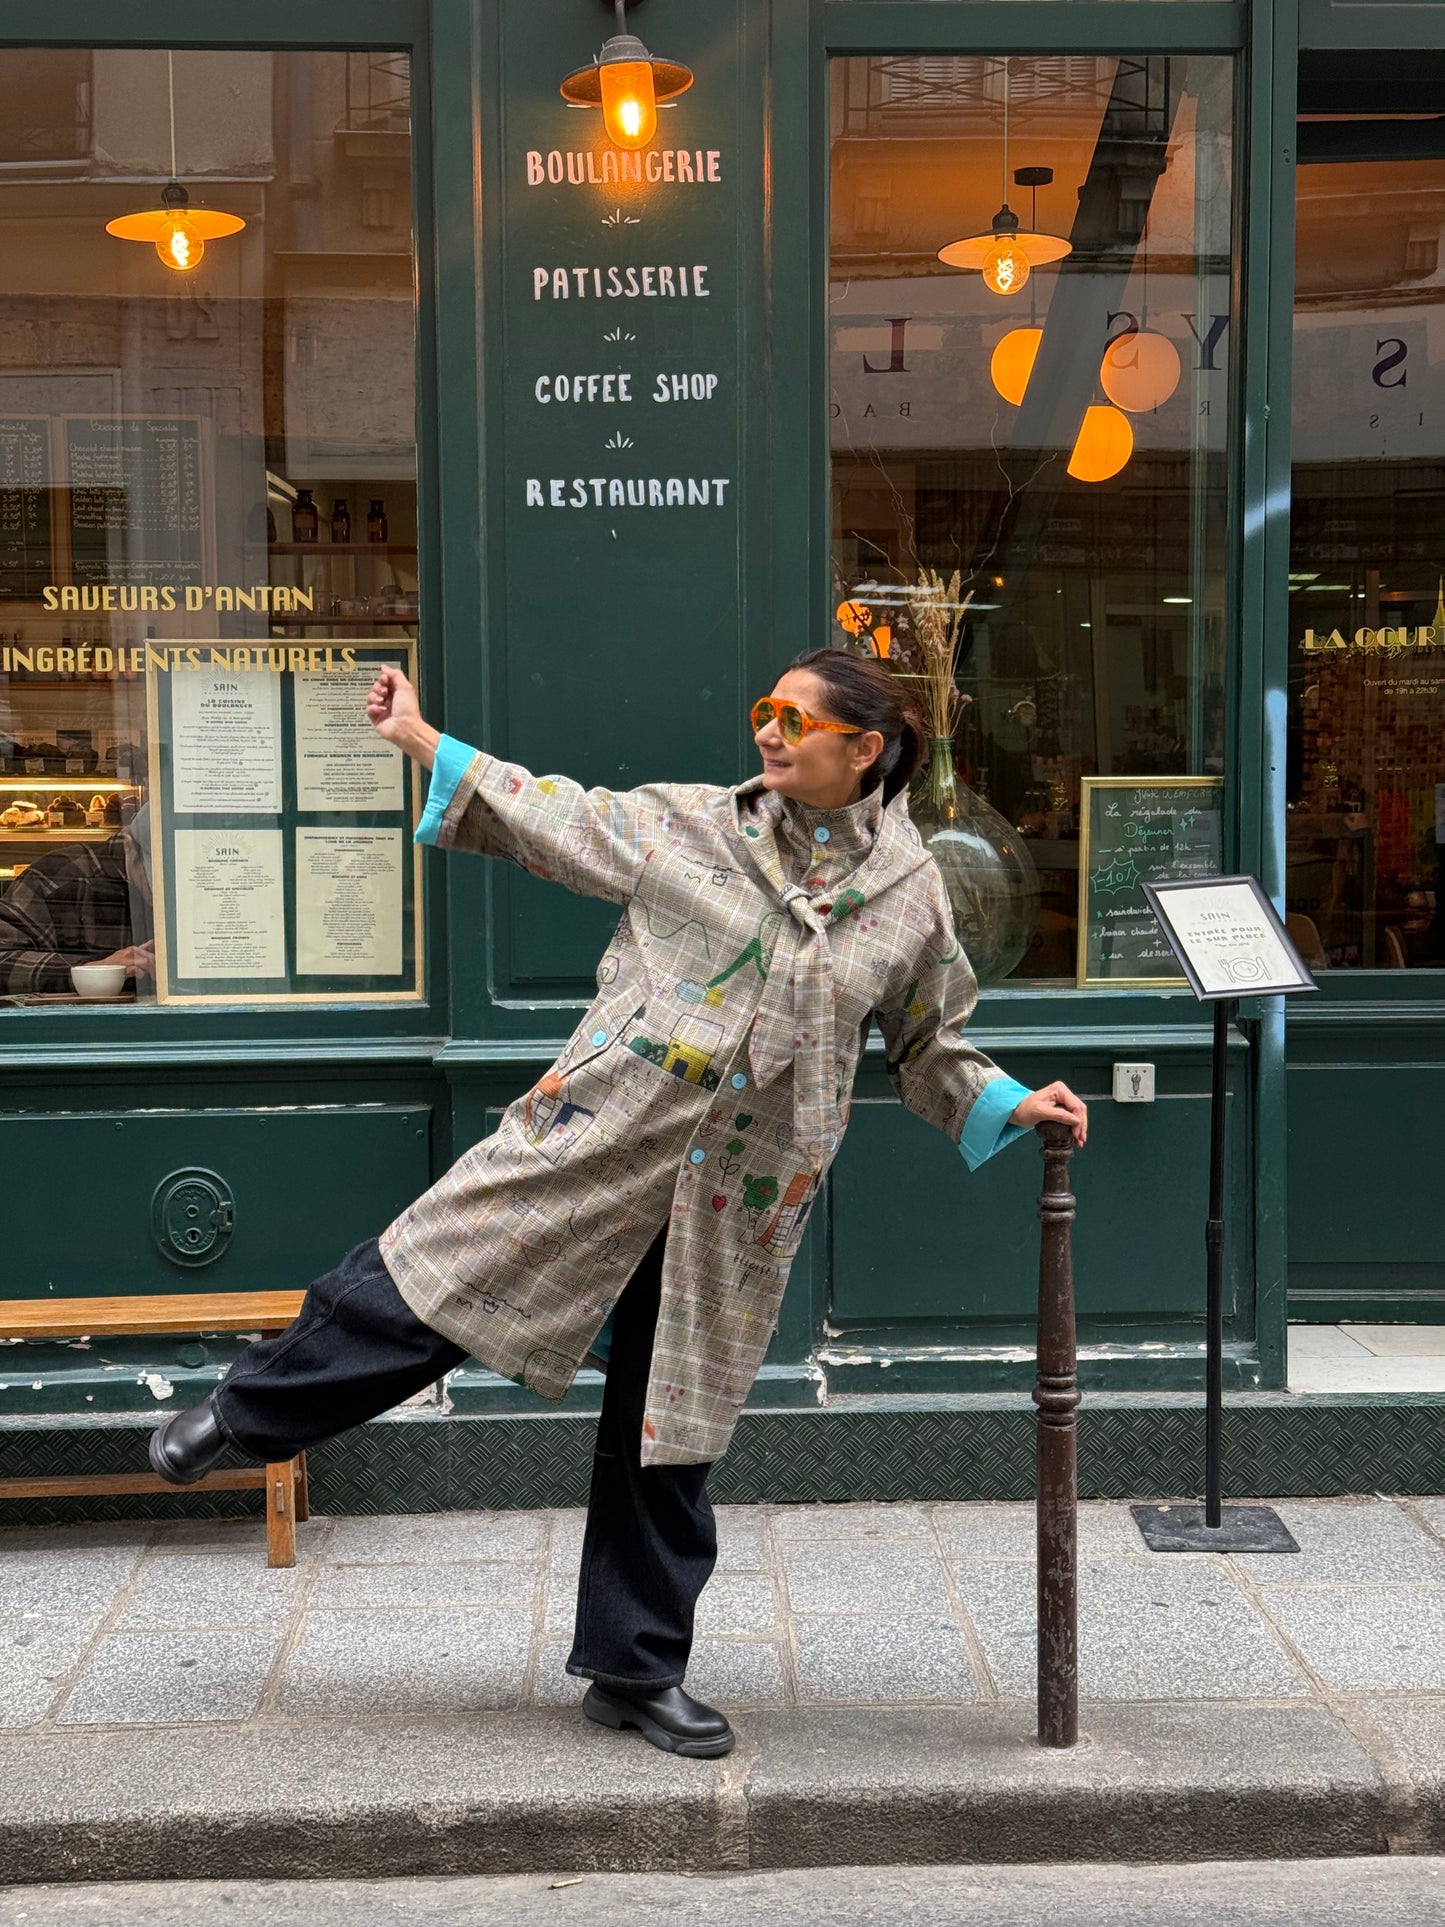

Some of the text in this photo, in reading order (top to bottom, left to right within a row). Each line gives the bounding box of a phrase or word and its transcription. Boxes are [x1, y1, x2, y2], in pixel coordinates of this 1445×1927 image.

[527, 149, 721, 186] BOULANGERIE
[533, 265, 710, 300] PATISSERIE
[535, 374, 718, 404] COFFEE SHOP
[527, 478, 730, 508] RESTAURANT
[43, 586, 177, 612] SAVEURS
[1305, 628, 1347, 649] LA
[3, 642, 356, 673] INGRÉDIENTS NATURELS
[214, 683, 238, 691] SAIN
[1363, 679, 1387, 687] Ouvert
[1416, 687, 1438, 695] 22h30
[1105, 803, 1202, 823] La régalade du
[1123, 822, 1175, 844] Déjeuner
[215, 848, 240, 856] SAIN
[1148, 864, 1166, 872] sur
[1200, 912, 1231, 921] SAIN
[1187, 928, 1227, 937] ENTRÉE
[1232, 933, 1267, 941] PLACE
